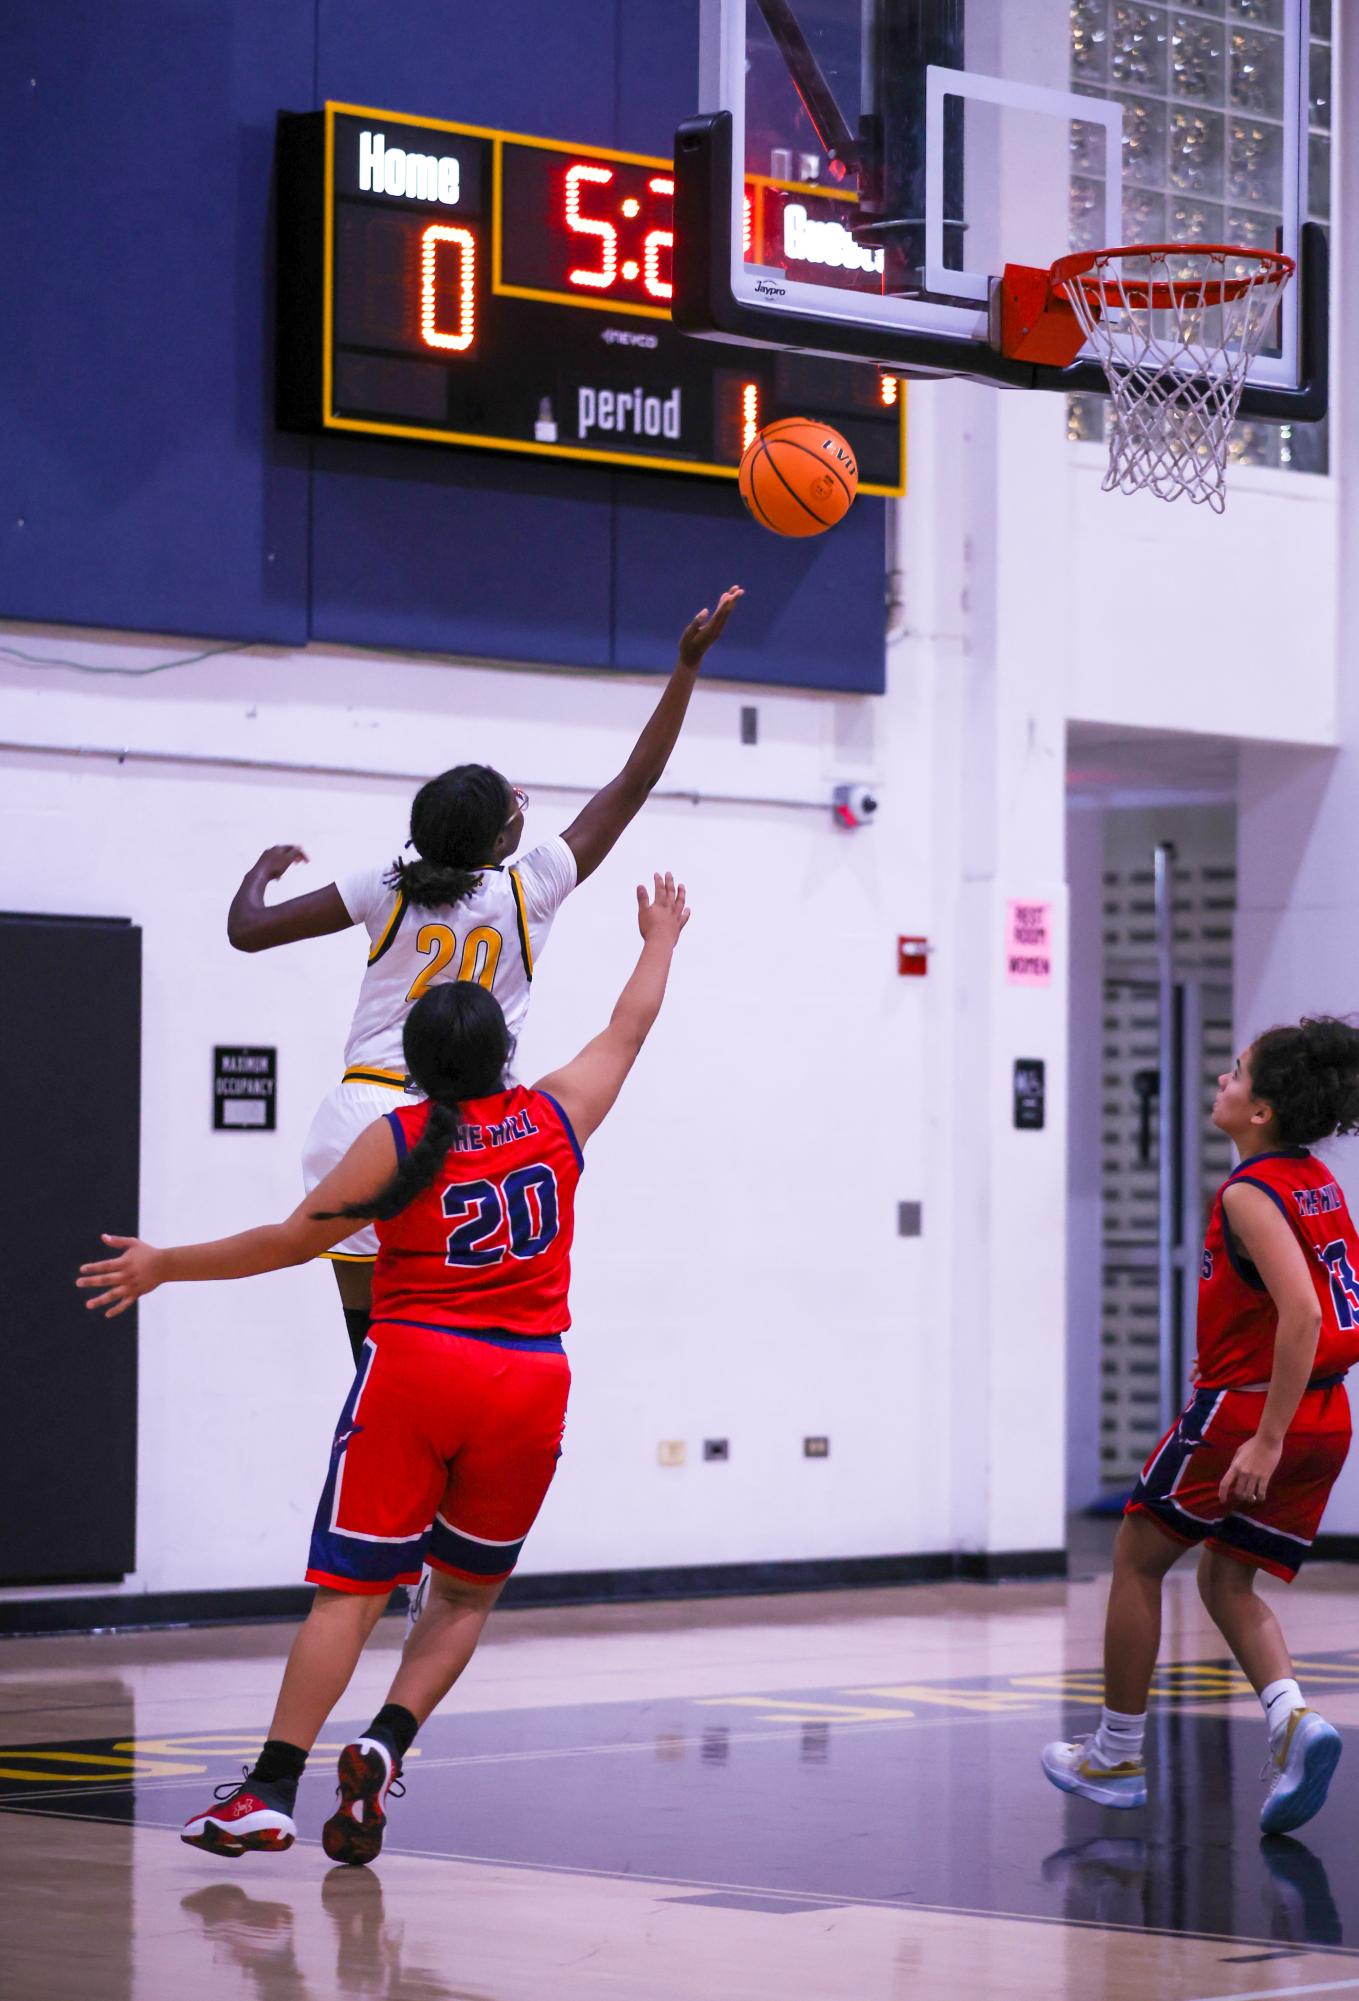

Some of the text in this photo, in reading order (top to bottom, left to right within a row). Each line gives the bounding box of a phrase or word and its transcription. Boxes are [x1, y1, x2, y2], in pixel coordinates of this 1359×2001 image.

[359, 131, 460, 205] Home
[422, 225, 475, 350] 0
[755, 281, 786, 296] Jaypro
[578, 386, 681, 439] period
[406, 923, 502, 1002] 20
[1010, 957, 1049, 976] WOMEN
[446, 1108, 539, 1153] HE HILL
[441, 1162, 559, 1268] 20
